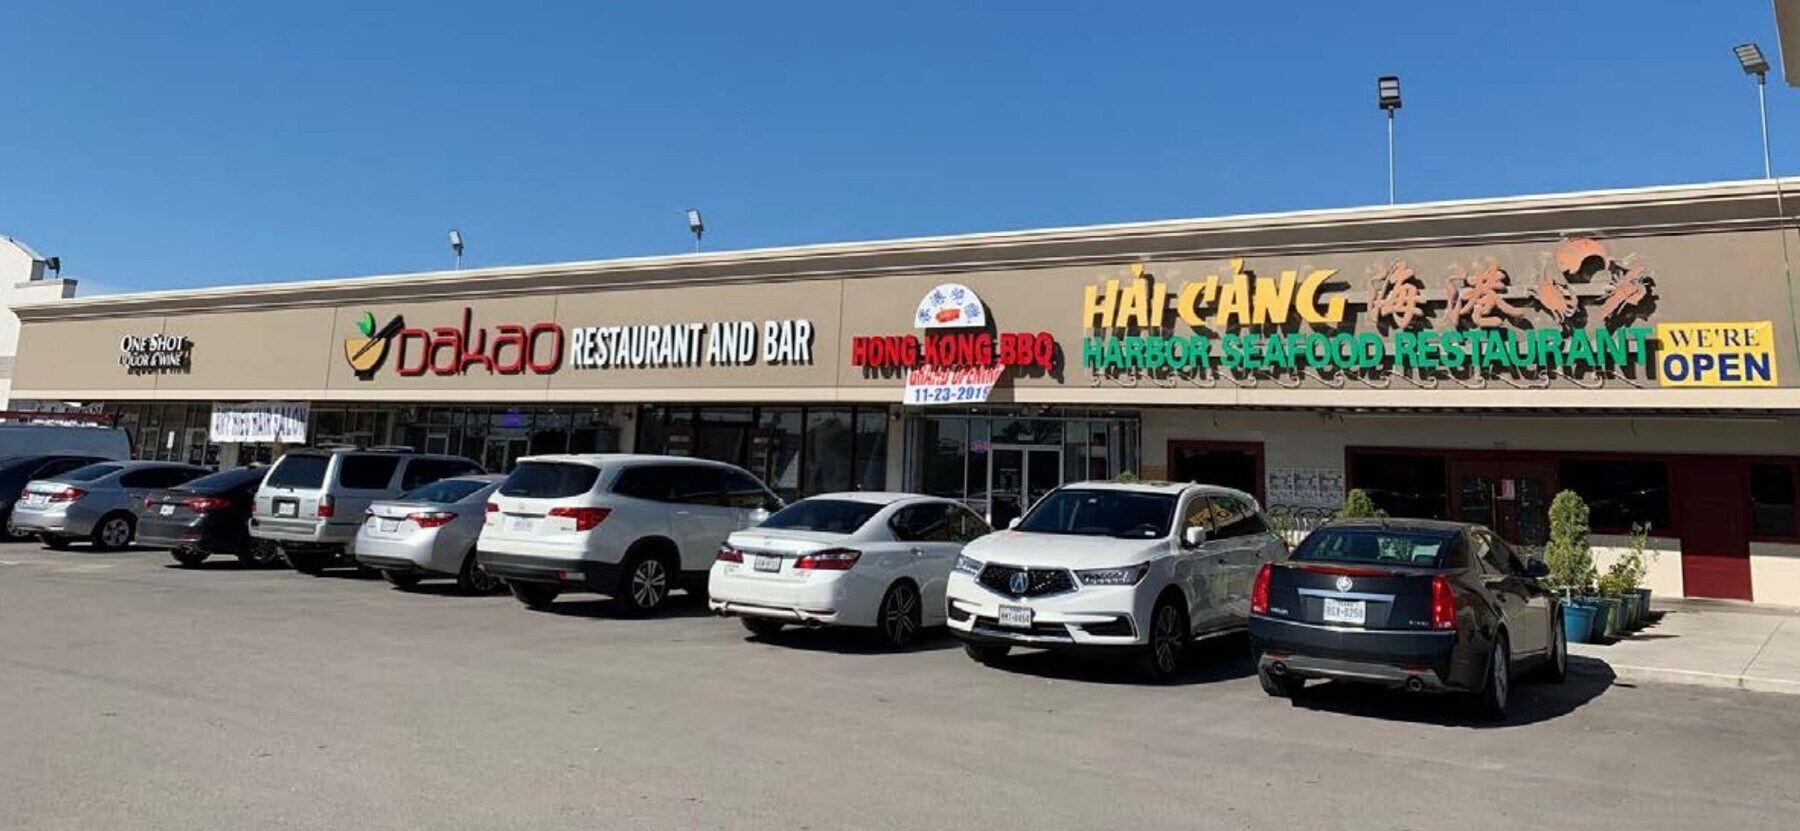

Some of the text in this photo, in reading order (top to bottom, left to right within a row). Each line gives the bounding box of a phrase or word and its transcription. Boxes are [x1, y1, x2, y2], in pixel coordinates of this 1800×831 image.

[121, 333, 184, 352] ONE SHOT
[570, 323, 704, 366] RESTAURANT
[706, 321, 757, 363] AND
[763, 319, 812, 362] BAR
[852, 331, 1054, 371] HONG KONG BBQ
[1082, 326, 1653, 369] HARBOR SEAFOOD RESTAURANT
[1669, 328, 1760, 347] WE'RE
[1663, 352, 1771, 381] OPEN
